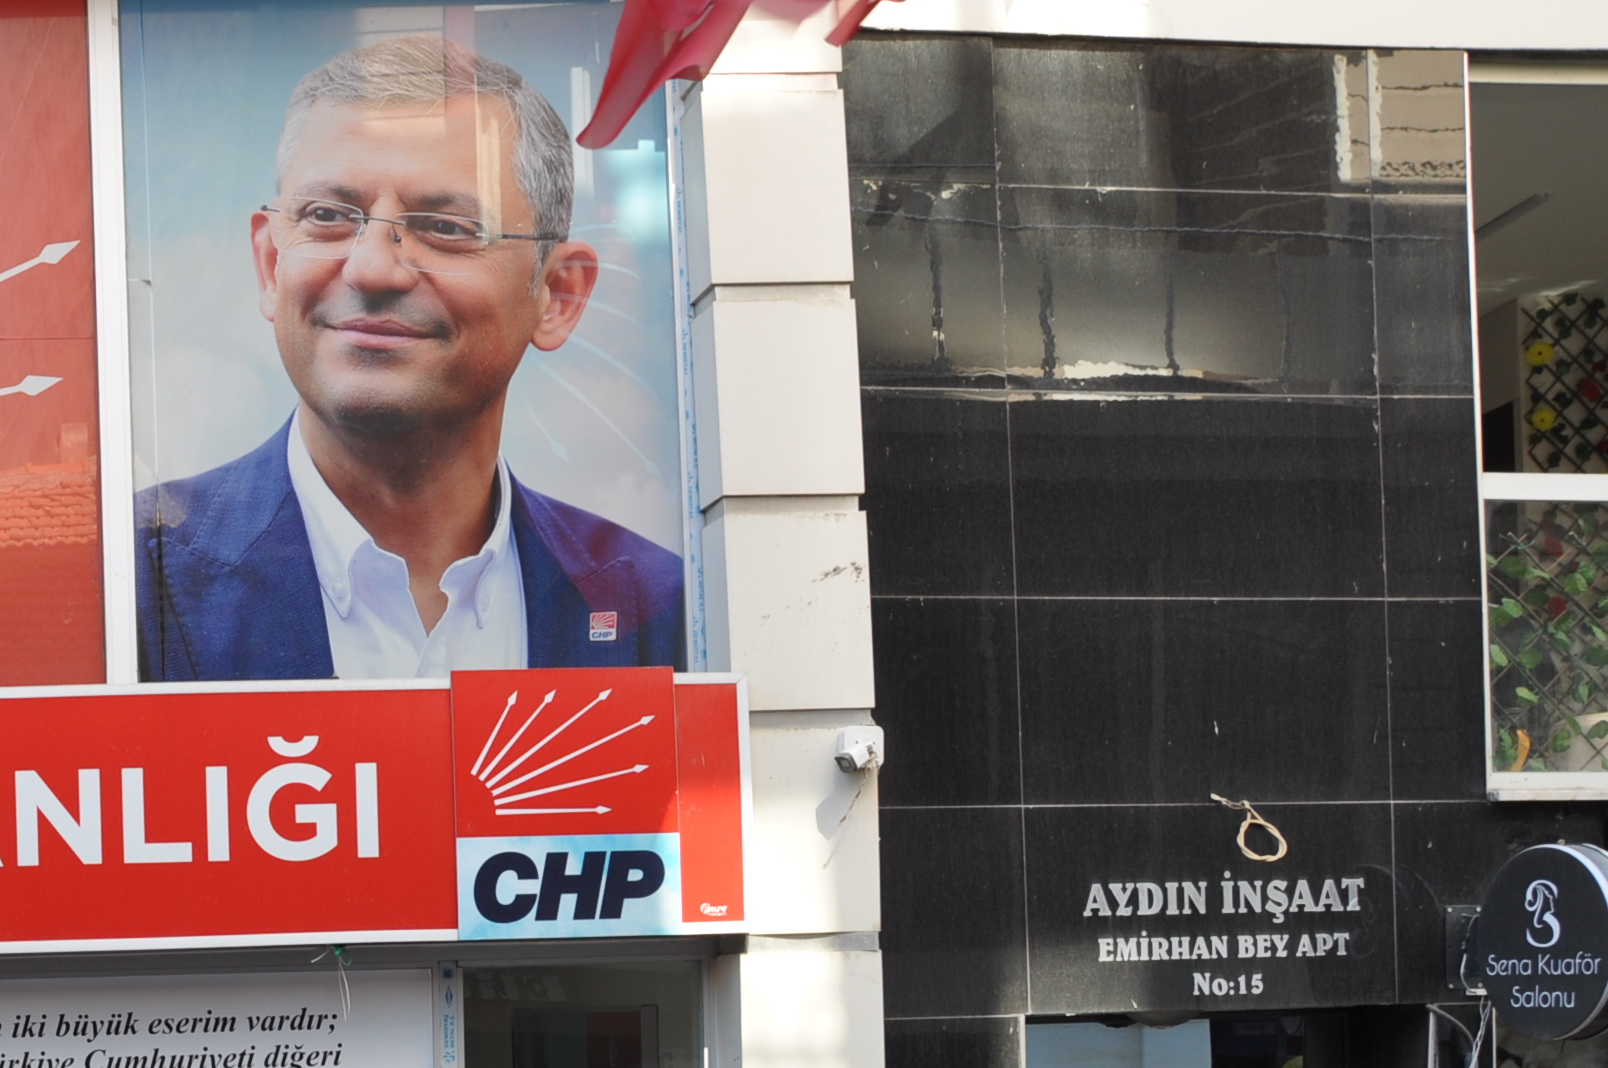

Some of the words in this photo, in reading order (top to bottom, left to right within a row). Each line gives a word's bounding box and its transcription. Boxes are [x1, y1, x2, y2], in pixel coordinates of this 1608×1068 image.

[472, 849, 666, 923] CHP
[1083, 880, 1207, 918] AYDIN
[1222, 871, 1365, 923] İNŞAAT
[1098, 930, 1229, 962] EMİRHAN
[1238, 934, 1288, 959] BEY
[1297, 933, 1350, 958] APT
[1486, 953, 1531, 976] Sena
[1538, 952, 1601, 976] Kuaför
[1192, 972, 1264, 997] No:15
[1510, 986, 1575, 1009] Salonu
[12, 1013, 46, 1040] iki
[55, 1011, 138, 1045] büyük
[148, 1010, 236, 1035] eserim
[247, 1007, 338, 1036] vardır;
